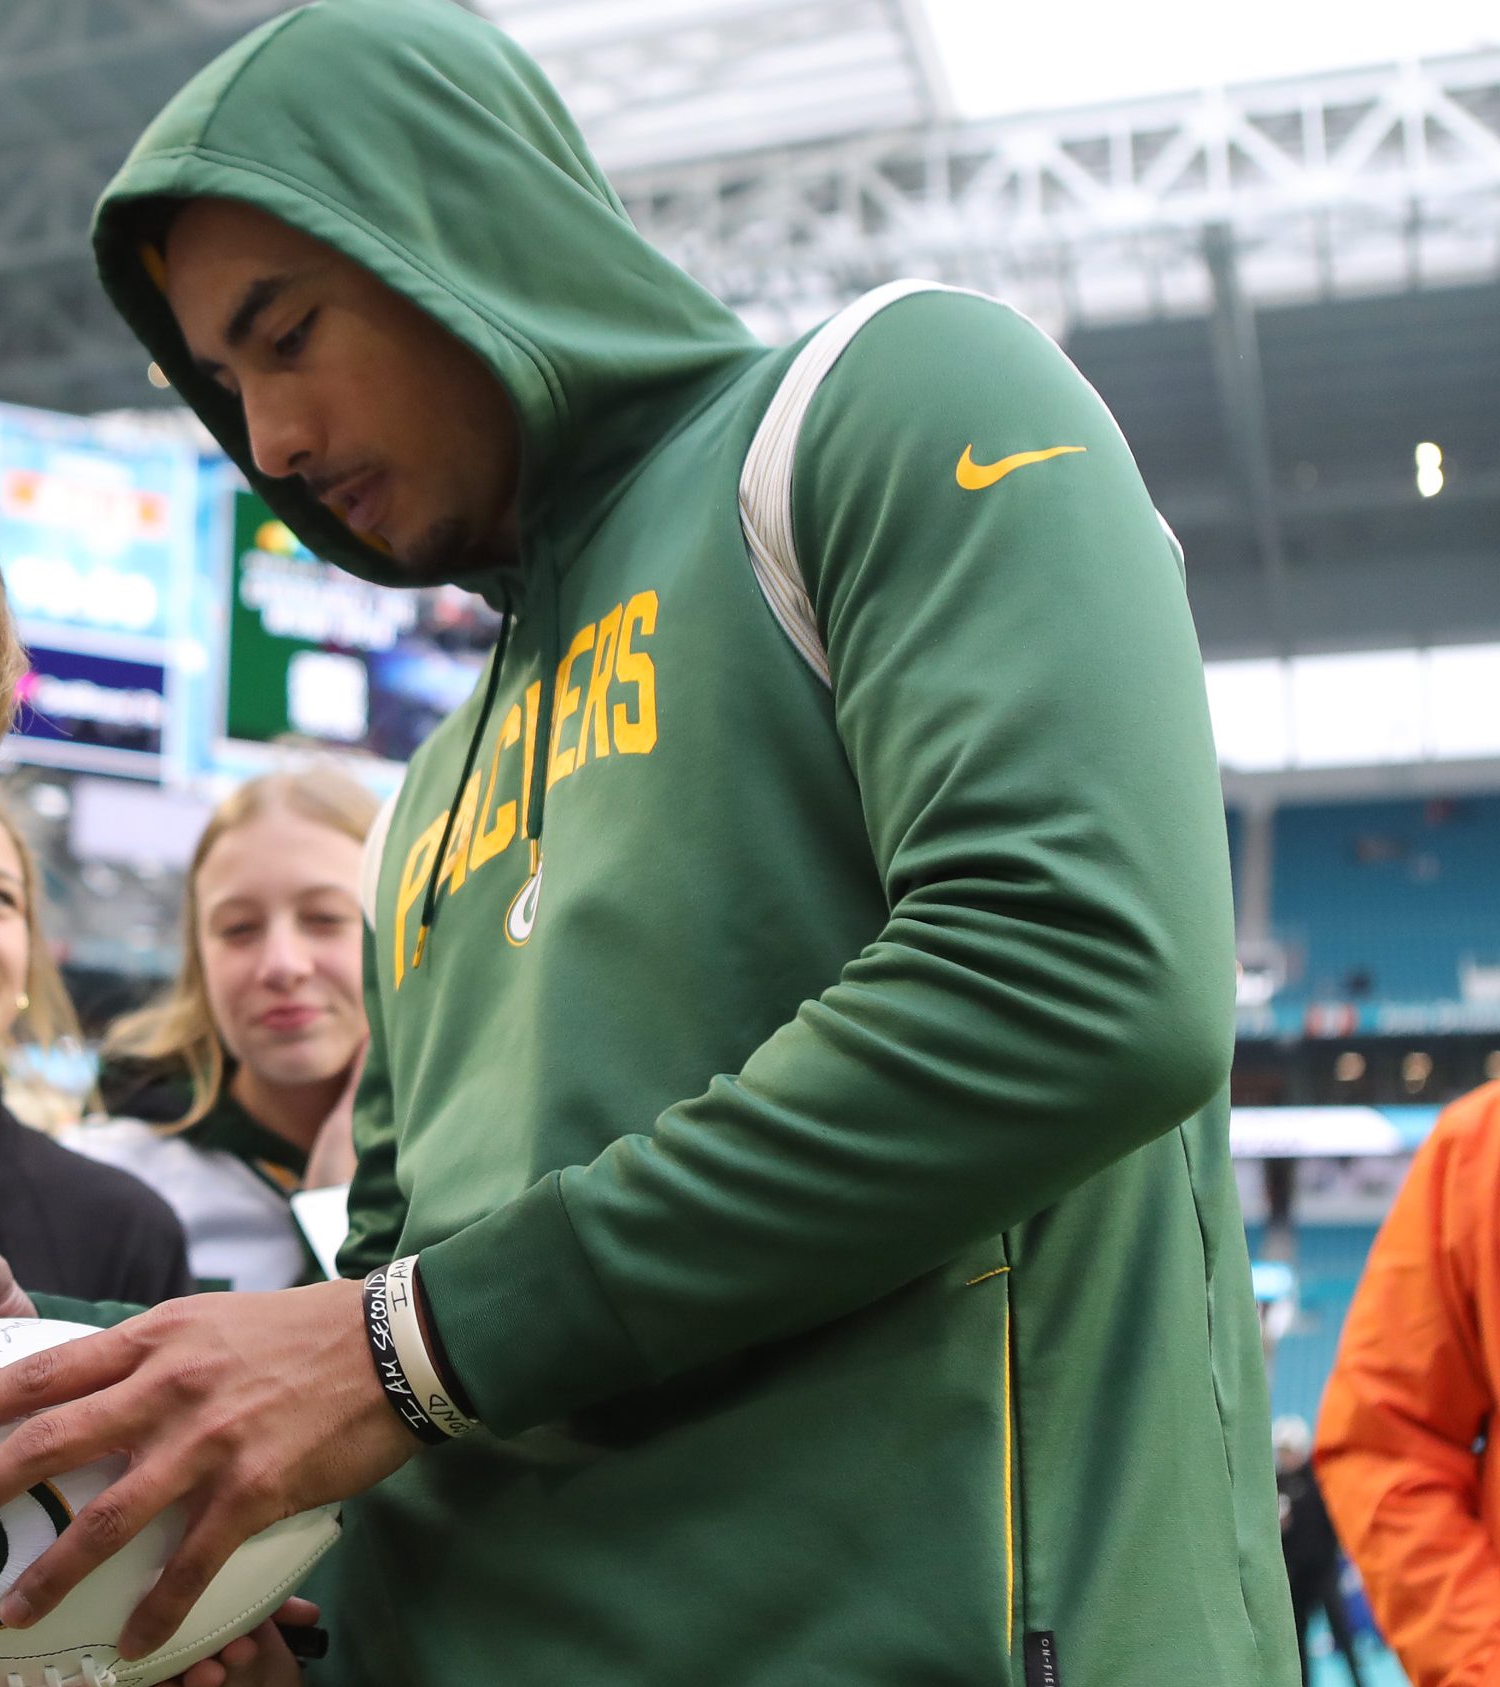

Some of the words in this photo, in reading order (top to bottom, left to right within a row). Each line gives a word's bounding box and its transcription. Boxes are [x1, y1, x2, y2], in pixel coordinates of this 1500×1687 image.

[364, 1272, 396, 1352] SECOND
[380, 1359, 412, 1395] AM
[400, 1399, 429, 1429] I
